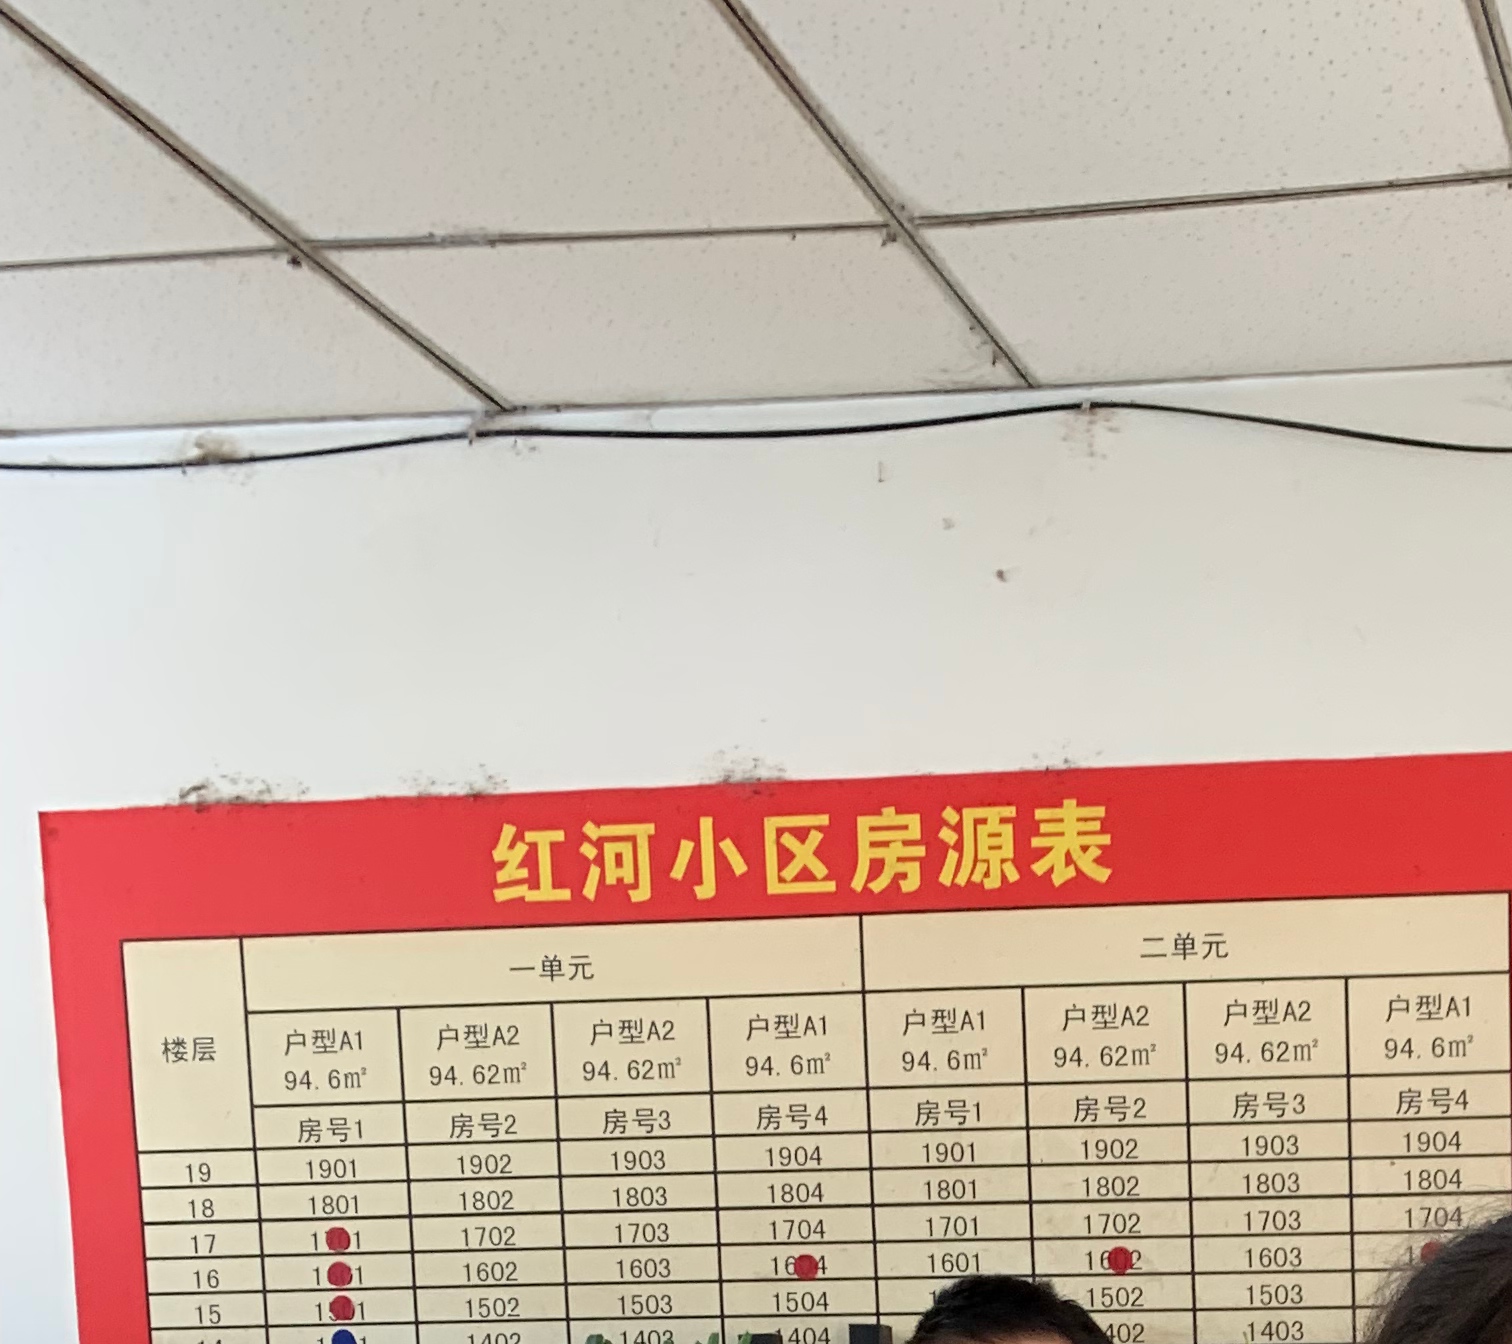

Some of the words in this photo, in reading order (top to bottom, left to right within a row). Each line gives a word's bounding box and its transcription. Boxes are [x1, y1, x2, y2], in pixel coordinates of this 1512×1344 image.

[492, 798, 1113, 903] 红河小区房源表
[510, 955, 594, 981] 一单元
[1141, 933, 1228, 960] 二单元
[285, 1028, 361, 1055] 户型A1
[437, 1024, 519, 1050] 户型A2
[591, 1019, 674, 1045] 户型A2
[747, 1014, 826, 1040] 户型A1
[903, 1008, 984, 1035] 户型A1
[1063, 1004, 1149, 1031] 户型A2
[1224, 999, 1311, 1026] 户型A2
[1386, 994, 1469, 1022] 户型A1
[162, 1037, 216, 1062] 楼层
[298, 1118, 362, 1143] 房号1
[450, 1113, 517, 1138] 房号2
[603, 1109, 671, 1134] 房号3
[757, 1104, 827, 1130] 房号4
[916, 1100, 980, 1126] 房号1
[1074, 1096, 1146, 1122] 房号2
[1233, 1092, 1305, 1118] 房号3
[1396, 1088, 1468, 1114] 房号4
[187, 1163, 210, 1182] 19
[307, 1159, 355, 1179] 1901
[458, 1154, 512, 1174] 1902
[612, 1150, 665, 1174] 1903
[767, 1146, 822, 1166] 1904
[923, 1142, 974, 1162] 1901
[1080, 1139, 1138, 1163] 1902
[1244, 1135, 1298, 1159] 1903
[1405, 1131, 1461, 1152] 1904
[189, 1199, 214, 1218] 18
[309, 1195, 358, 1214] 1801
[460, 1190, 514, 1210] 1802
[613, 1187, 667, 1207] 1803
[768, 1183, 822, 1203] 1804
[927, 1180, 975, 1200] 1801
[1083, 1176, 1139, 1197] 1802
[1243, 1172, 1299, 1194] 1803
[1405, 1169, 1462, 1193] 1804
[191, 1234, 216, 1254] 17
[311, 1230, 361, 1252] 11
[462, 1226, 515, 1246] 1702
[614, 1223, 669, 1246] 1703
[772, 1220, 825, 1240] 1704
[927, 1216, 977, 1236] 1701
[1085, 1214, 1140, 1234] 1702
[1246, 1210, 1301, 1231] 1703
[1407, 1207, 1462, 1228] 1704
[194, 1269, 219, 1288] 16
[313, 1265, 363, 1287] 11
[464, 1262, 518, 1282] 1602
[617, 1259, 670, 1278] 1603
[771, 1256, 828, 1277] 164
[928, 1253, 979, 1272] 1601
[1247, 1247, 1301, 1268] 1603
[197, 1305, 220, 1324] 15
[467, 1298, 520, 1318] 1502
[620, 1295, 672, 1315] 1503
[774, 1292, 828, 1312] 1504
[1088, 1287, 1143, 1308] 1502
[1248, 1285, 1303, 1305] 1503
[1105, 1323, 1145, 1344] 402
[1247, 1321, 1304, 1344] 1403
